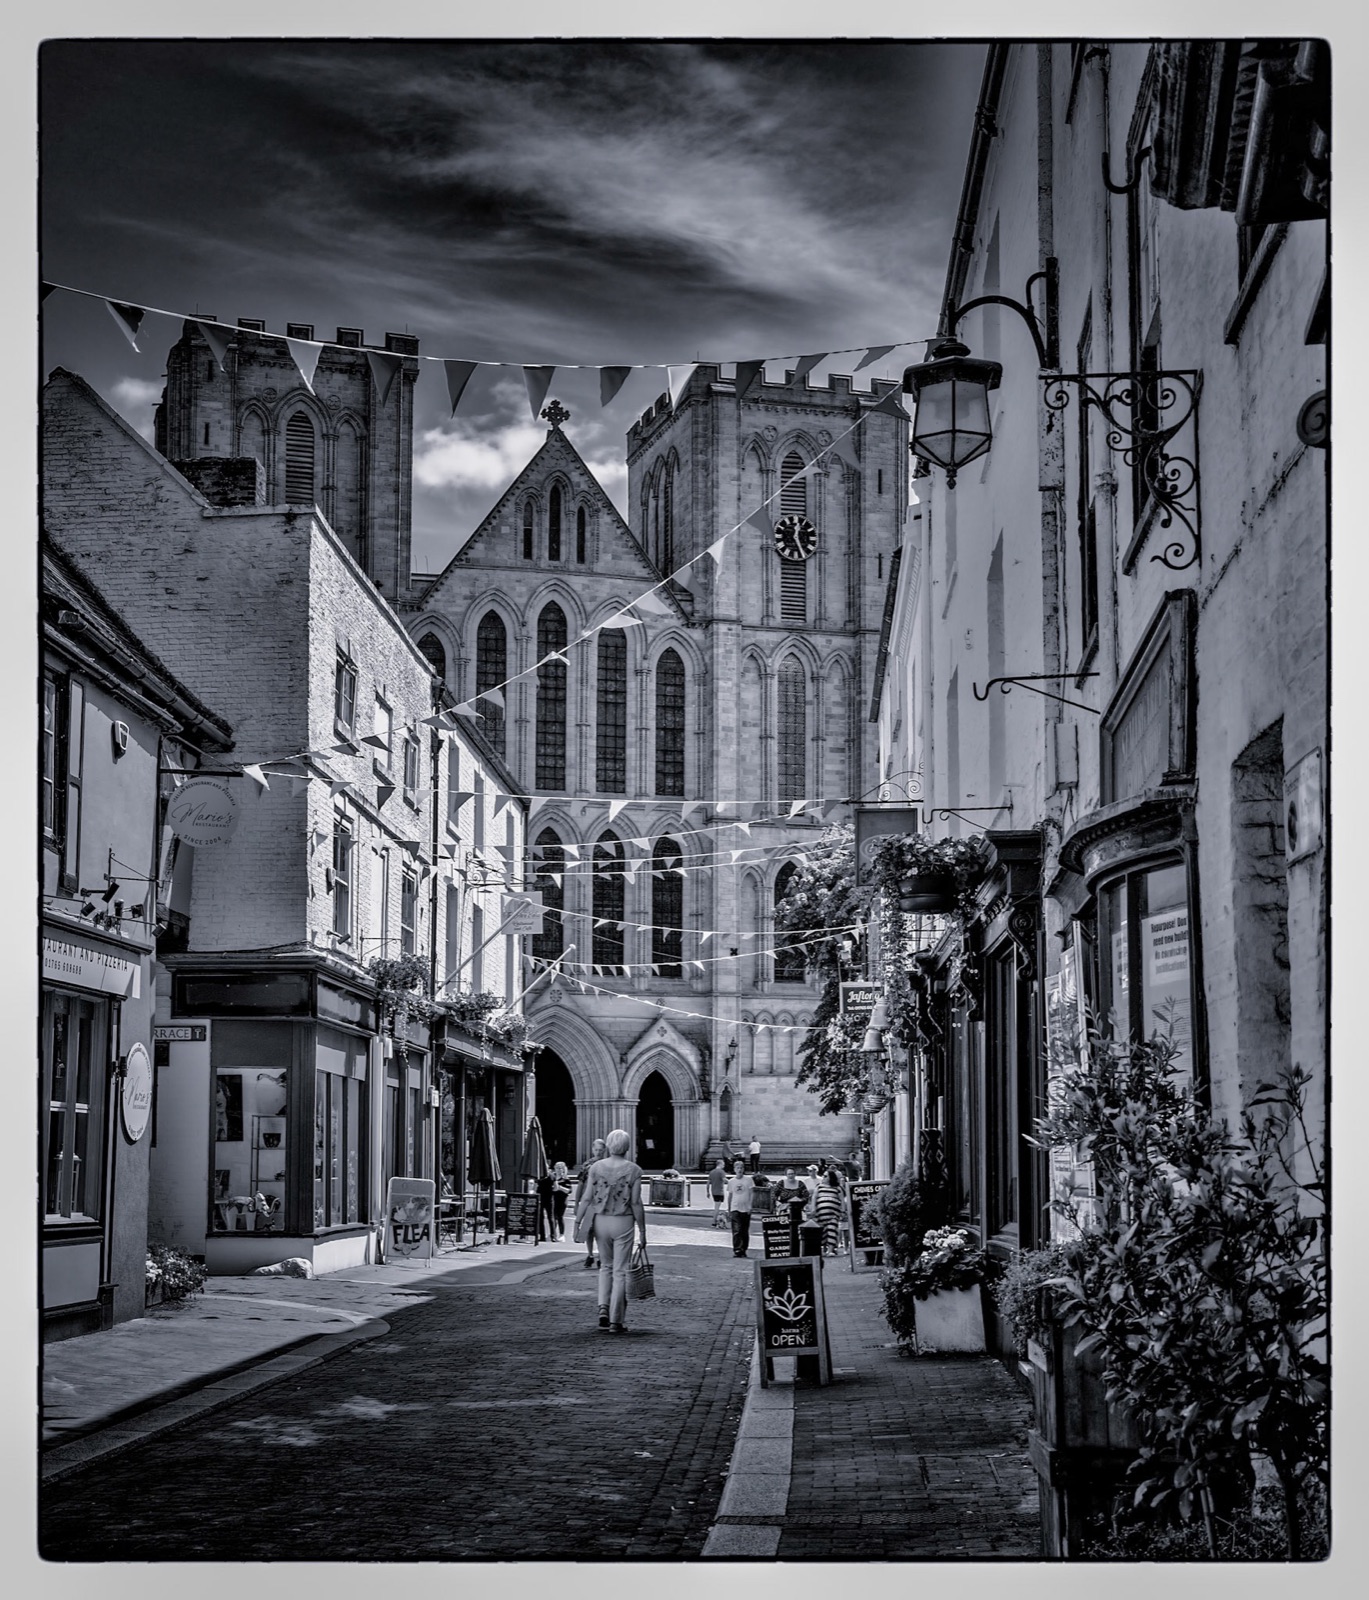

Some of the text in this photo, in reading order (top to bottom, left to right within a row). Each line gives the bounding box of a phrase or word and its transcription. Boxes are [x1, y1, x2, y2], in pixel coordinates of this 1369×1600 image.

[171, 802, 235, 826] Mario's
[184, 834, 203, 845] SINCE
[44, 957, 61, 971] 01765
[80, 946, 95, 963] AND
[97, 951, 128, 972] PIZZERIA
[392, 1223, 430, 1244] FLEA
[771, 1334, 805, 1346] OPEN
